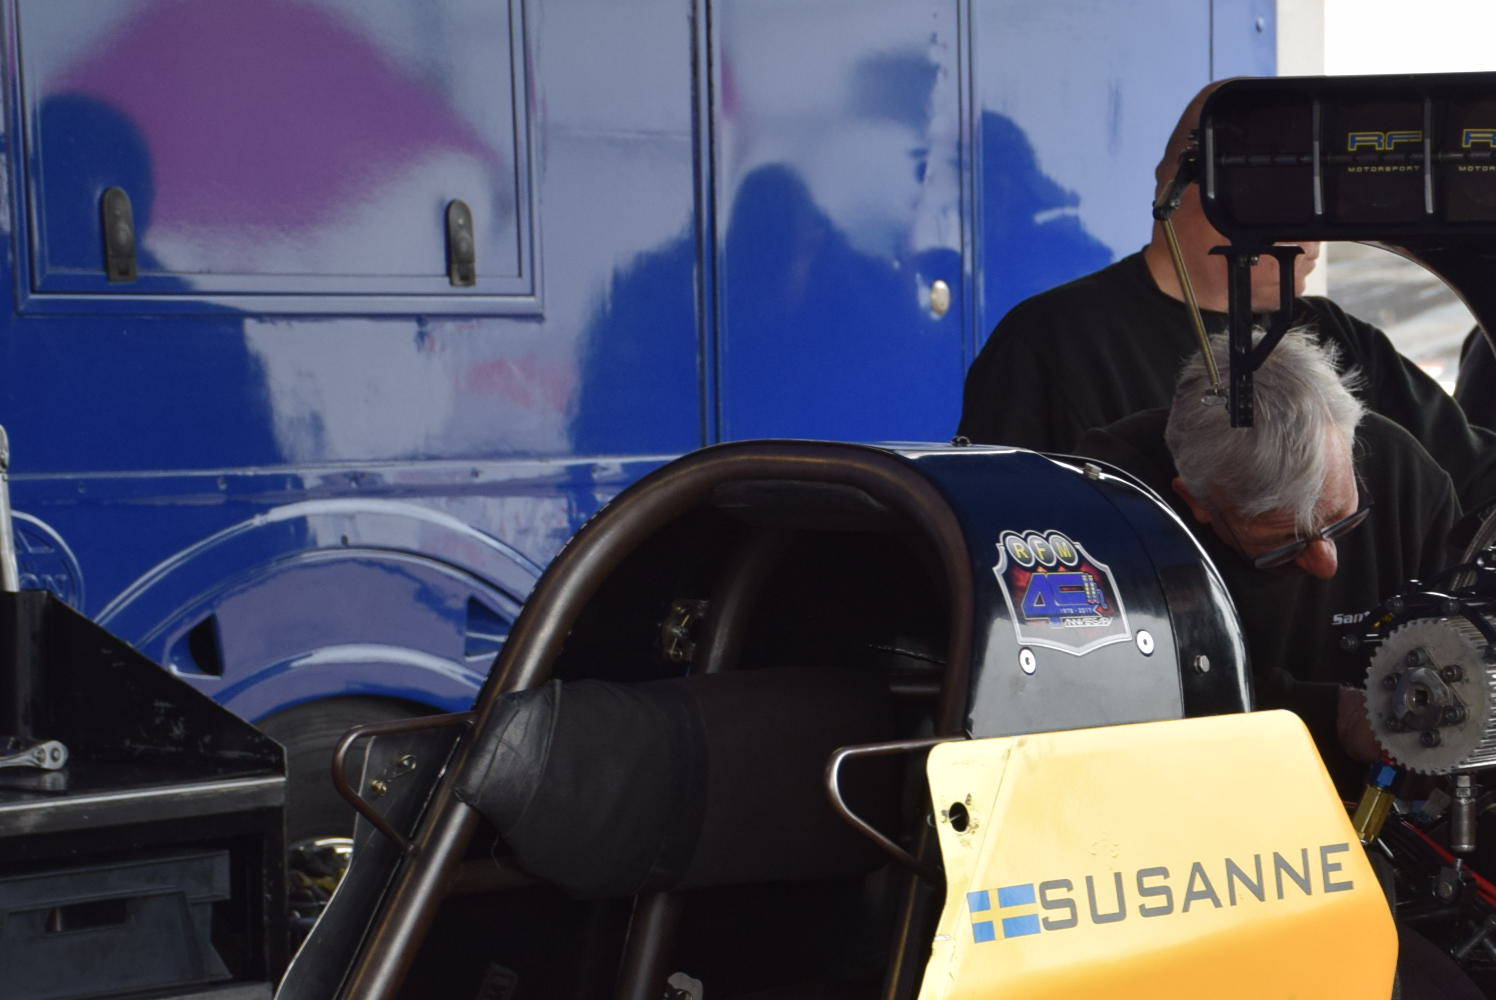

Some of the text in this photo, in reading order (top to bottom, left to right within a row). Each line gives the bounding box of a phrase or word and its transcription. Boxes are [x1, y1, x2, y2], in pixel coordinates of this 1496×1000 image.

[1348, 131, 1422, 151] RF
[1348, 165, 1421, 173] MOTORSPORT
[1012, 540, 1072, 561] RFM
[1039, 843, 1353, 931] SUSANNE
